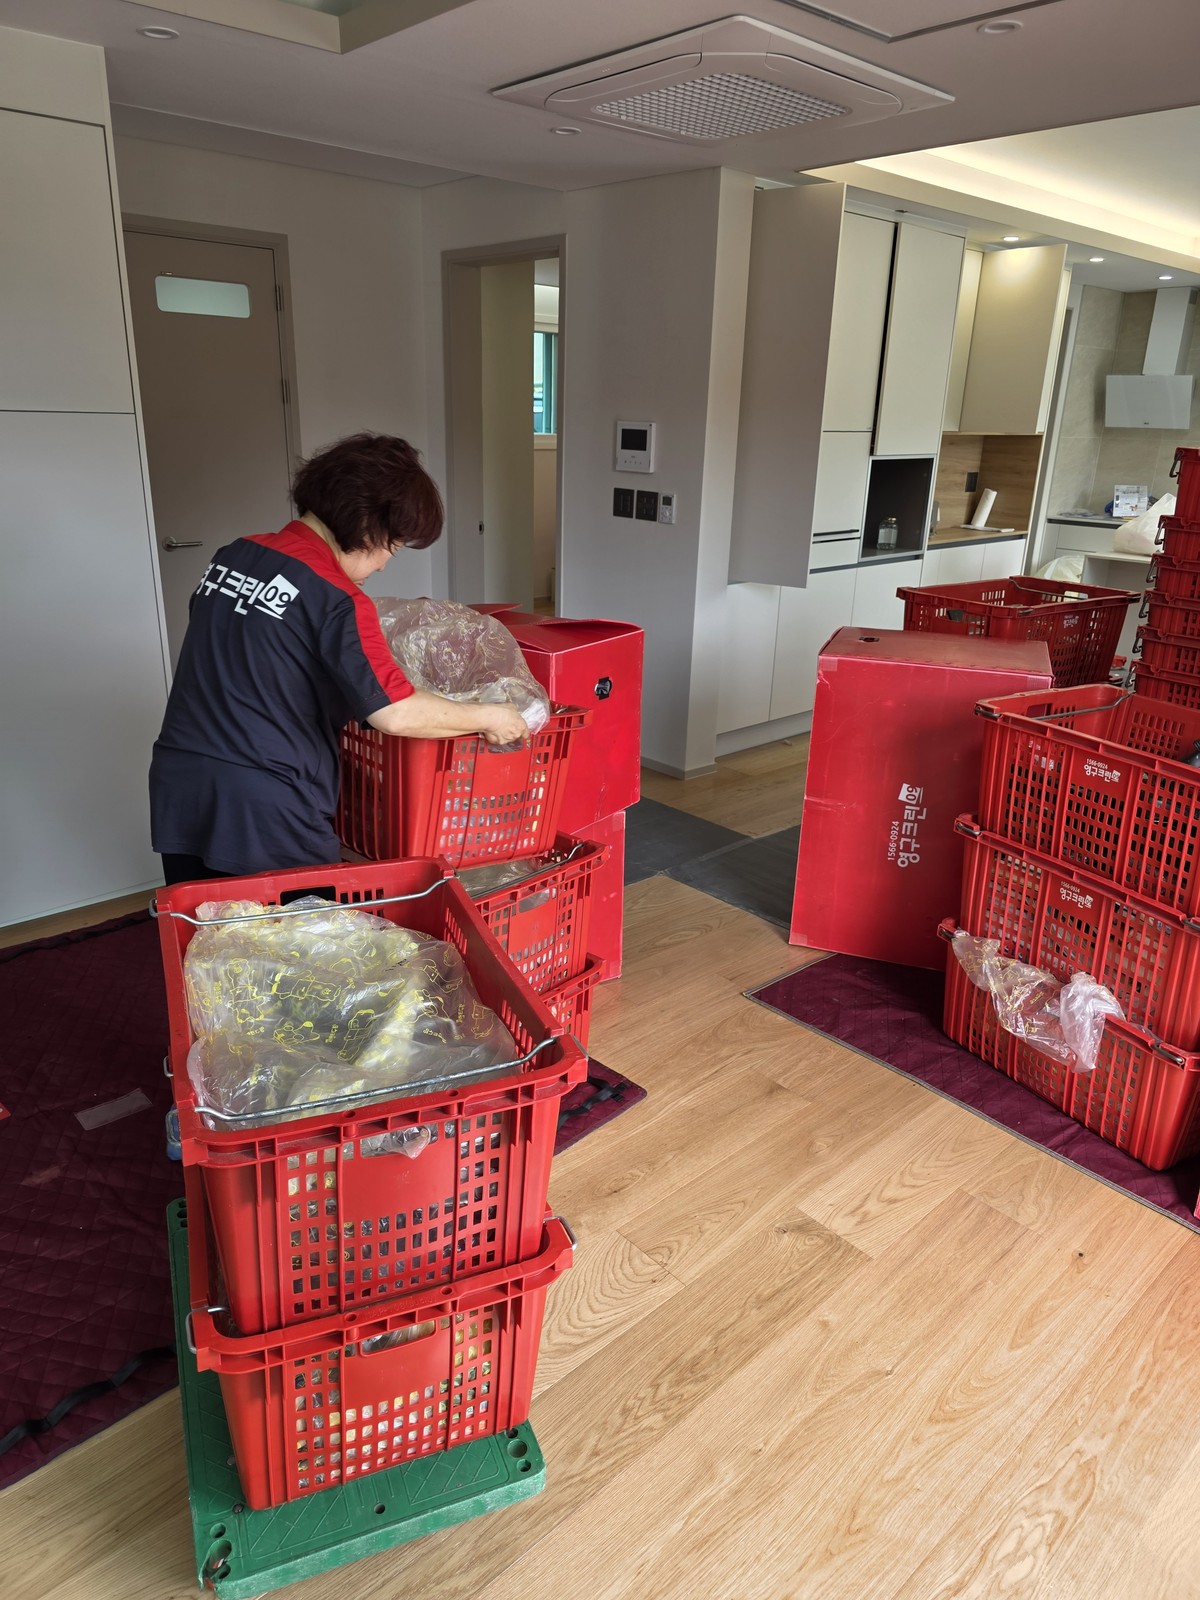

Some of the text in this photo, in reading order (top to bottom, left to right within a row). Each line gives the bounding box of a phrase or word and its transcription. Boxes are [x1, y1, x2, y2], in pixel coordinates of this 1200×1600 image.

[1084, 764, 1111, 782] 영구크린
[897, 805, 927, 868] 영구크린
[1060, 888, 1084, 908] 영구크린
